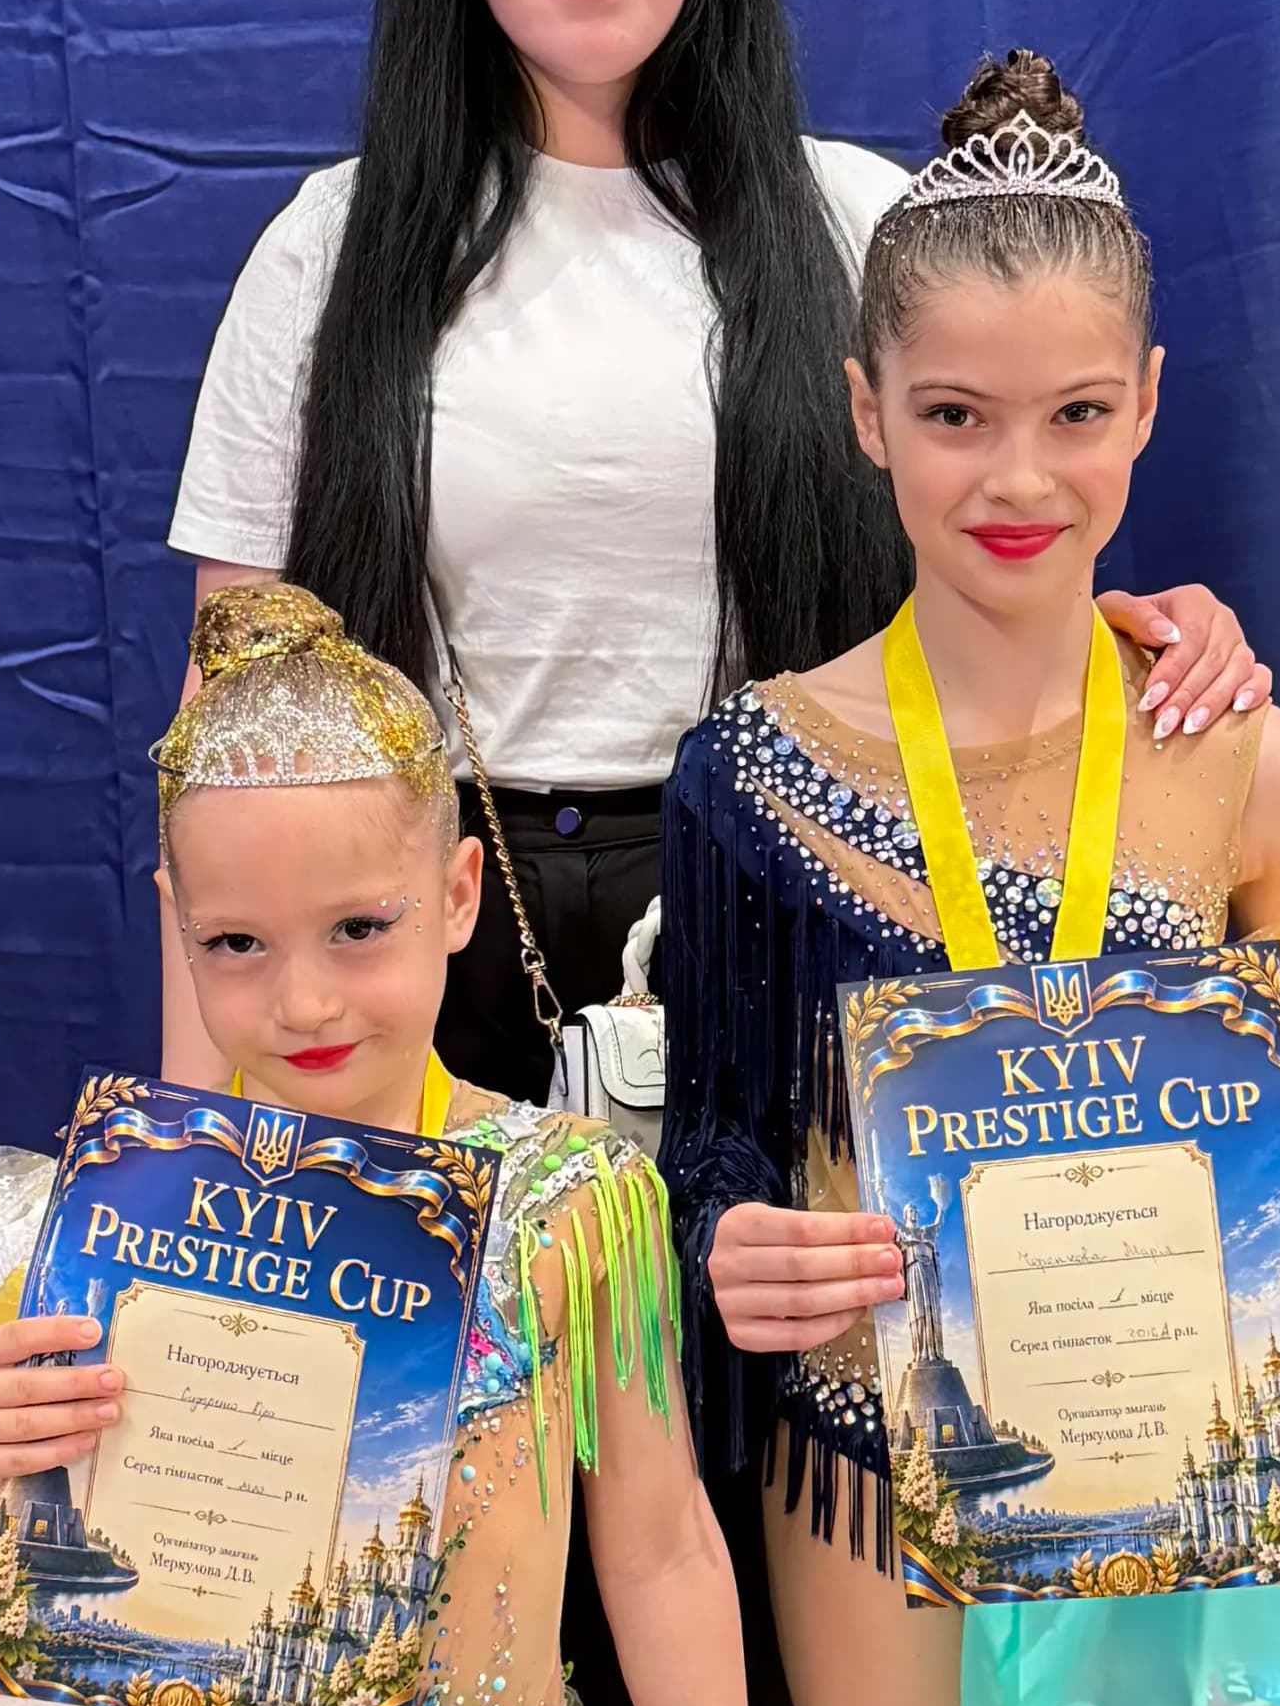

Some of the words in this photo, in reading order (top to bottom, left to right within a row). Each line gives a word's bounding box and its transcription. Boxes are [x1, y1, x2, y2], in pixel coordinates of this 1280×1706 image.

[997, 1035, 1146, 1096] KYIV
[903, 1094, 1144, 1156] PRESTIGE
[1159, 1078, 1260, 1129] CUP
[184, 1177, 338, 1251] KYIV
[1024, 1206, 1158, 1231] Нагороджується
[80, 1204, 313, 1300] PRESTIGE
[329, 1258, 432, 1322] CUP
[1028, 1300, 1052, 1315] Яка
[1056, 1296, 1095, 1313] посіла
[1140, 1290, 1174, 1304] місце
[1010, 1337, 1049, 1353] Серед
[1053, 1334, 1112, 1350] гімнасток
[167, 1344, 300, 1385] Нагороджується
[149, 1426, 173, 1442] Яка
[177, 1434, 215, 1450] посіла
[260, 1449, 294, 1466] місце
[1060, 1427, 1133, 1446] Меркулова
[1137, 1421, 1168, 1439] Д.В.
[123, 1455, 161, 1475] Серед
[165, 1464, 224, 1487] гімнасток
[150, 1552, 221, 1577] Меркулова
[224, 1565, 256, 1584] Д.В.
